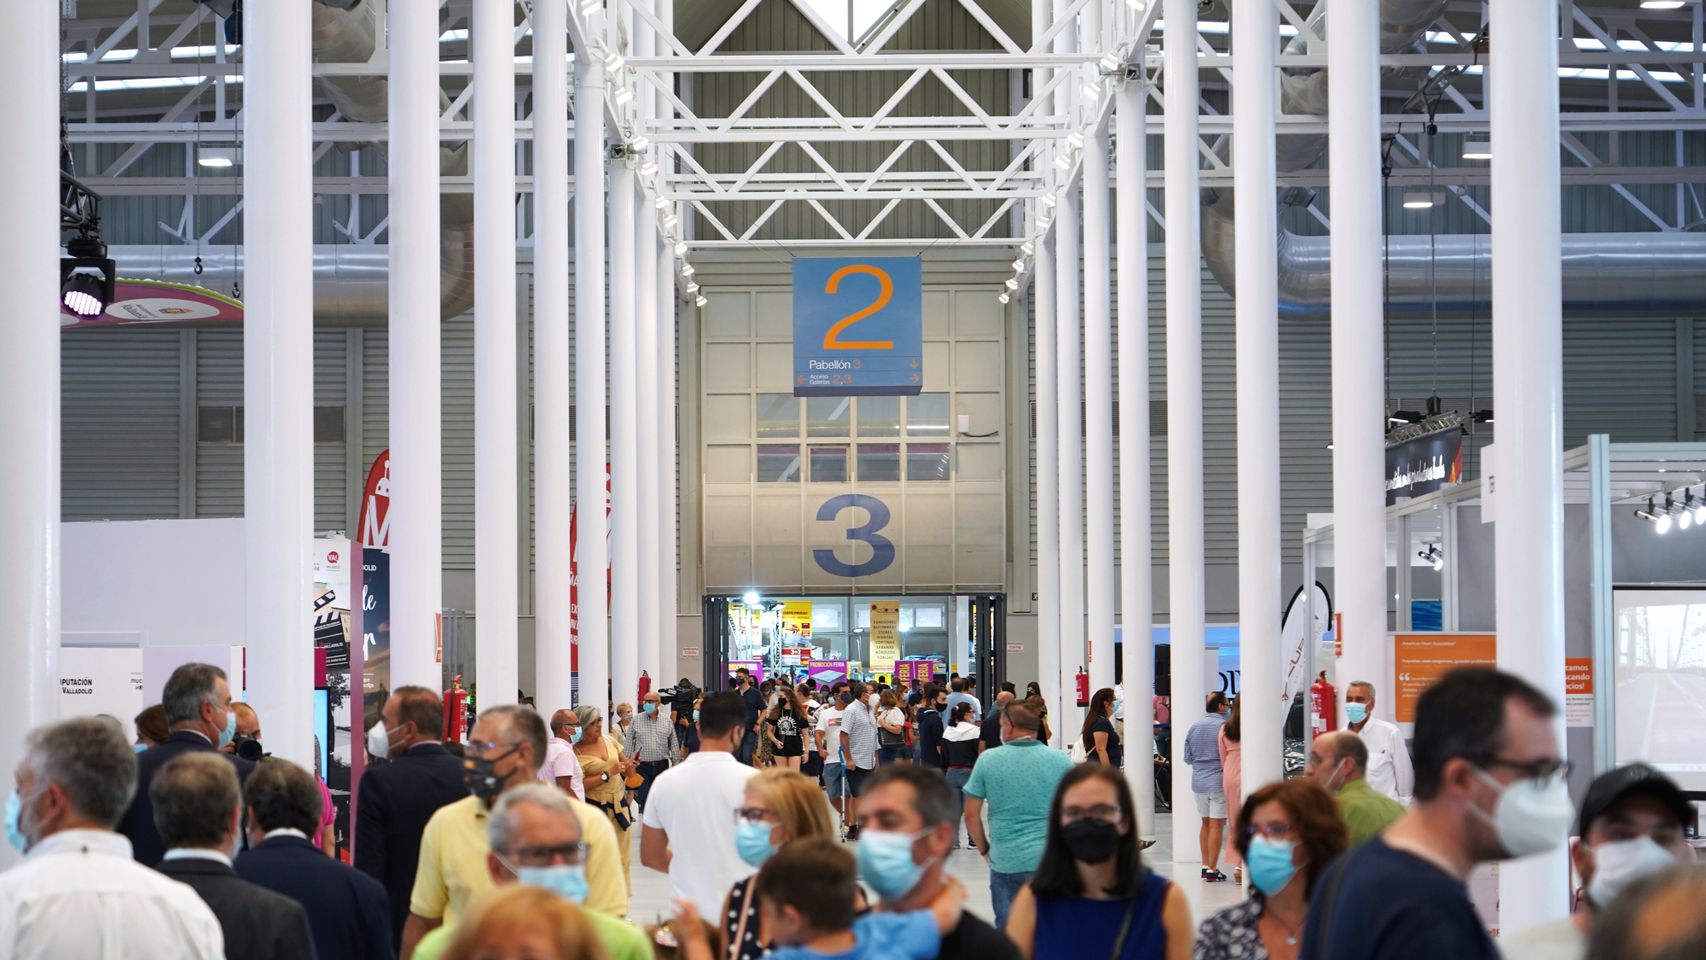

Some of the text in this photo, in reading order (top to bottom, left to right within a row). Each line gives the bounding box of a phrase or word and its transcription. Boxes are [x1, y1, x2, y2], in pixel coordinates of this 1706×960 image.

[824, 265, 894, 349] 2
[809, 359, 862, 370] Pabellón 3
[812, 493, 896, 578] 3
